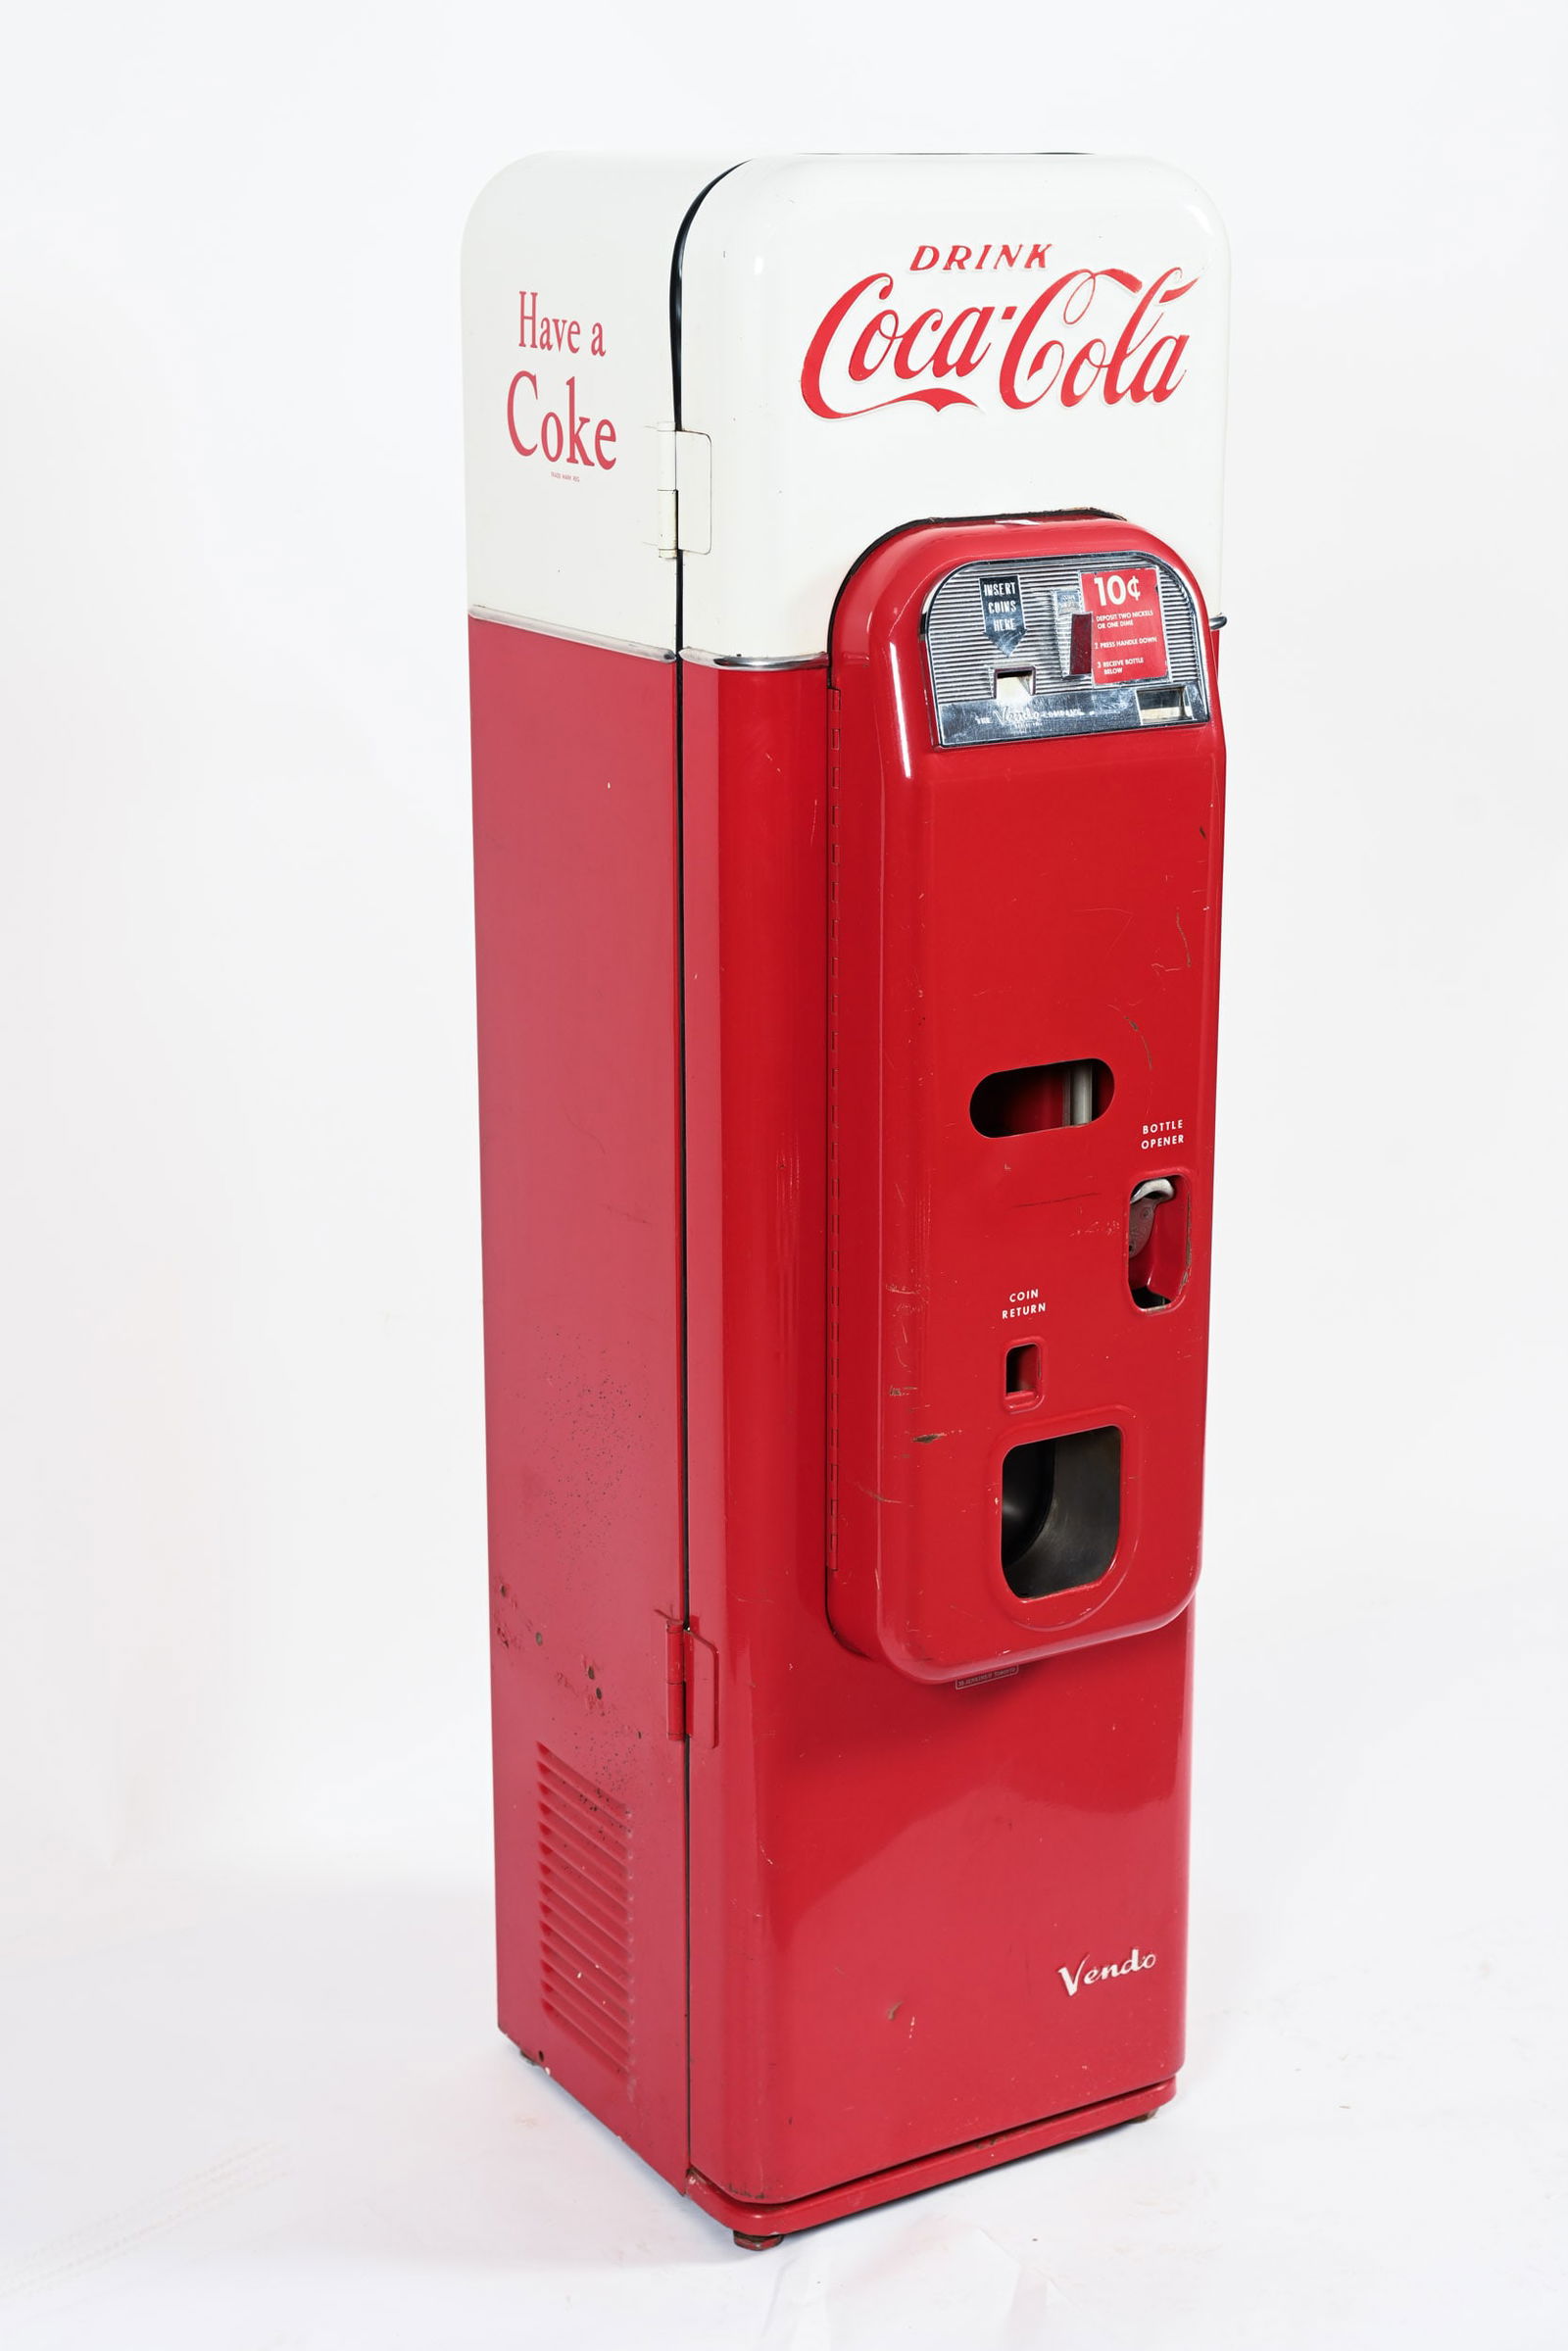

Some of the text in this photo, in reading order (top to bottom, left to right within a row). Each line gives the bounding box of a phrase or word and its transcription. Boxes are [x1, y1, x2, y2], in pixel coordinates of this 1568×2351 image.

[909, 243, 1054, 271] DRINK
[518, 290, 607, 357] Have a
[801, 268, 1201, 420] Coca-Cola
[507, 370, 616, 470] Coke
[983, 582, 1015, 596] INSERT
[1094, 574, 1141, 607] 10¢
[988, 600, 1016, 614] COINS
[1096, 612, 1117, 621] DEPOSIT
[1132, 610, 1153, 618] NICKELS
[993, 618, 1016, 632] HERE
[1100, 640, 1115, 649] PRESS
[1116, 638, 1138, 647] HANDLE
[1102, 659, 1124, 667] RECEIVE
[1103, 666, 1123, 675] BELOW
[1143, 1119, 1184, 1135] BOTTLE
[1141, 1134, 1185, 1150] OPENER
[1008, 1289, 1039, 1302] COIN
[1002, 1302, 1047, 1319] RETURN
[1057, 1948, 1156, 1996] Vendo
